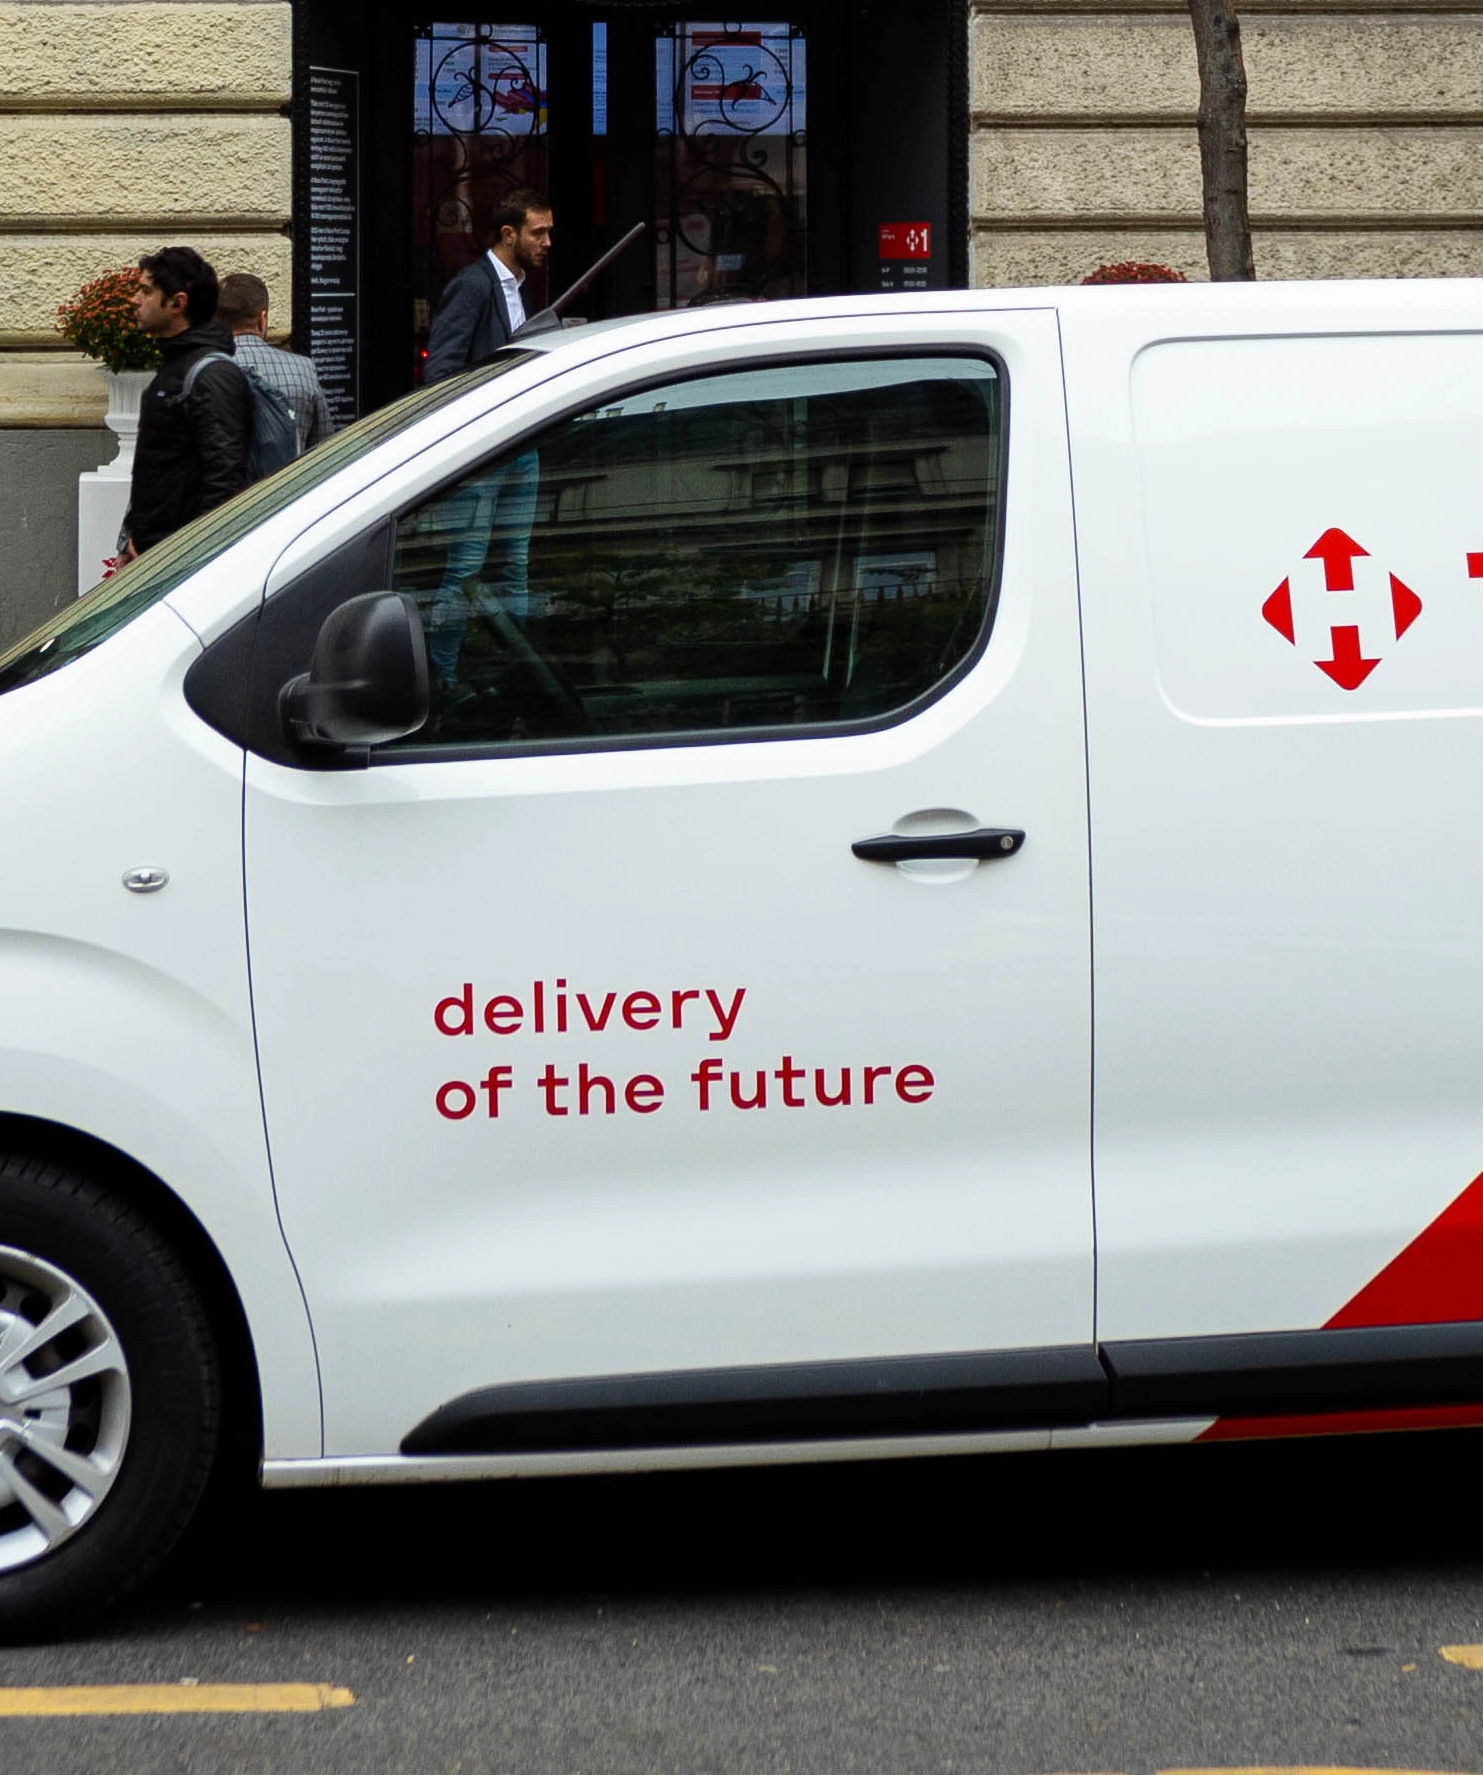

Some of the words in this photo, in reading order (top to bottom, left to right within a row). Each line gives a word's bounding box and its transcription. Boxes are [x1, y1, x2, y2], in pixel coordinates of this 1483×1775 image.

[433, 978, 747, 1042] delivery
[435, 1065, 514, 1120] of
[537, 1063, 664, 1117] the
[690, 1055, 935, 1112] future
